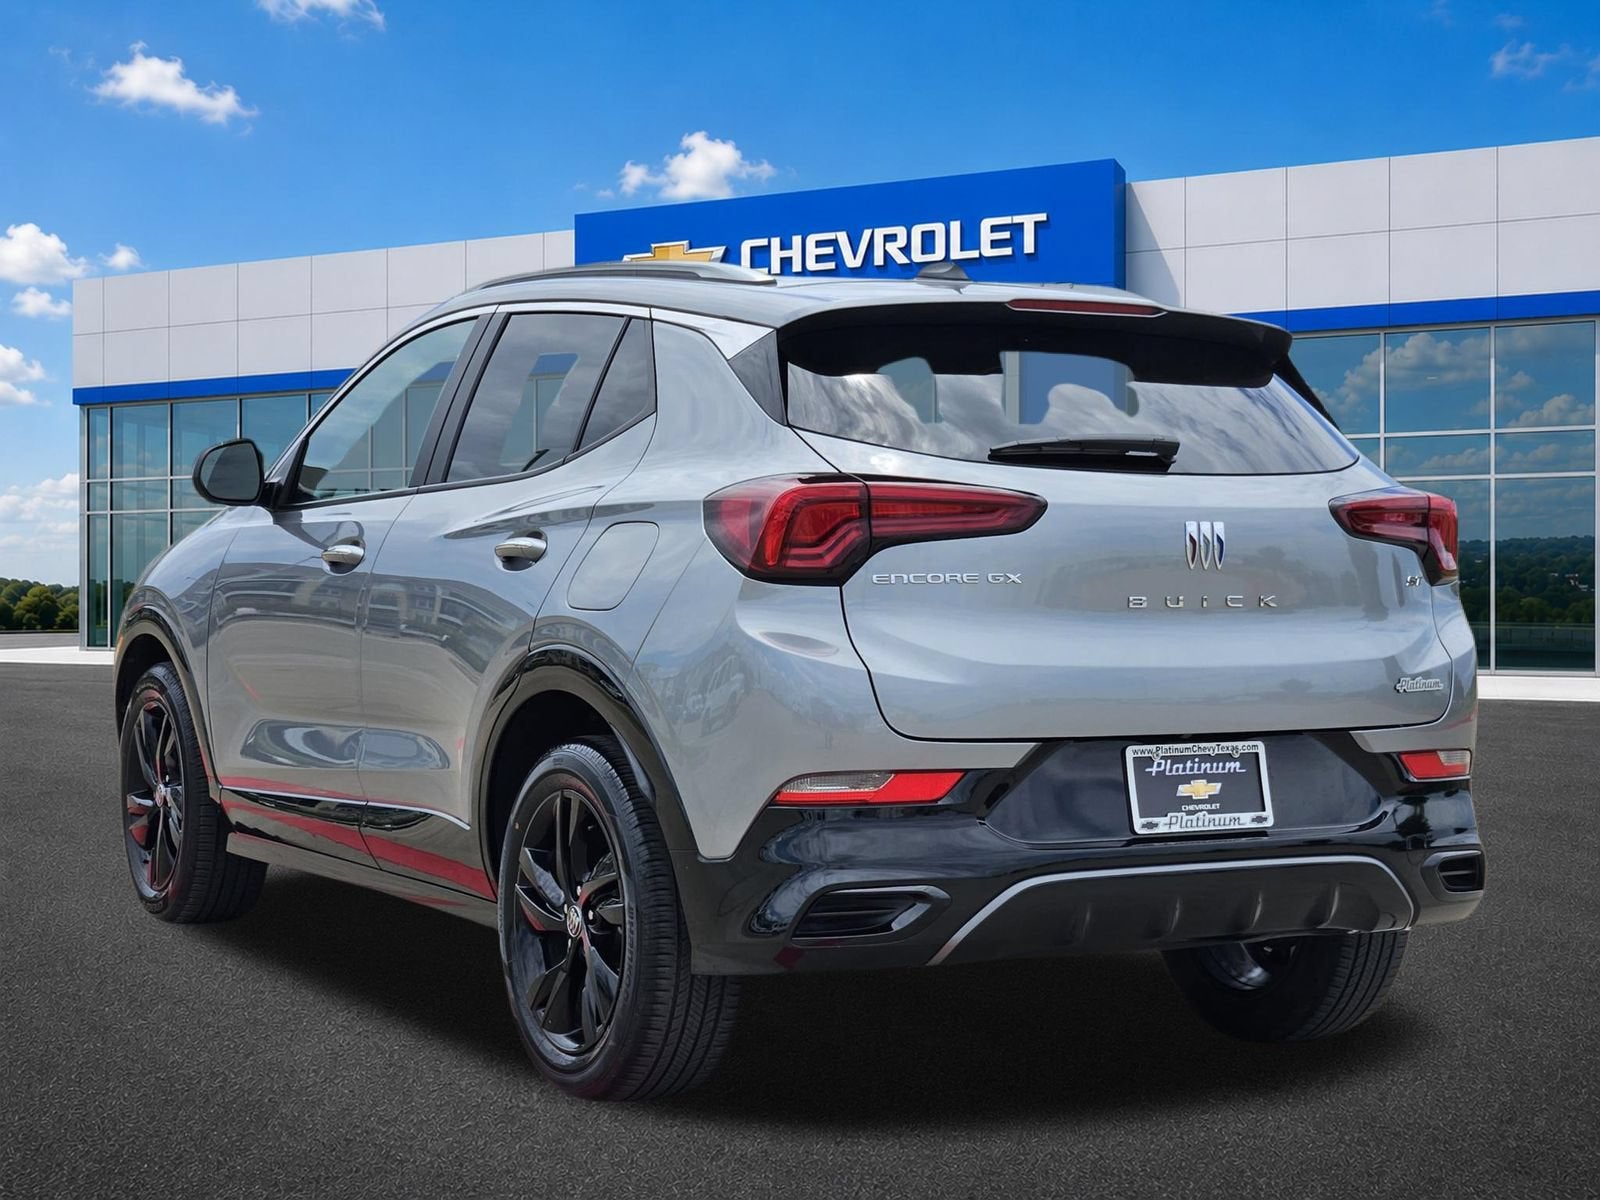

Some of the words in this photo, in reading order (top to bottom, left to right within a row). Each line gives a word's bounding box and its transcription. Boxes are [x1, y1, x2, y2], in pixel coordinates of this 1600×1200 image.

[741, 213, 1047, 274] CHEVROLET
[872, 572, 979, 585] ENCORE
[987, 572, 1023, 585] GX
[1128, 595, 1278, 609] BUICK
[1395, 676, 1444, 693] Platinum
[1132, 743, 1259, 756] www.PlatinumChevyTexas.com
[1145, 758, 1247, 776] Platinum
[1181, 803, 1221, 811] CHEVROLET
[1164, 813, 1247, 830] Platinum
